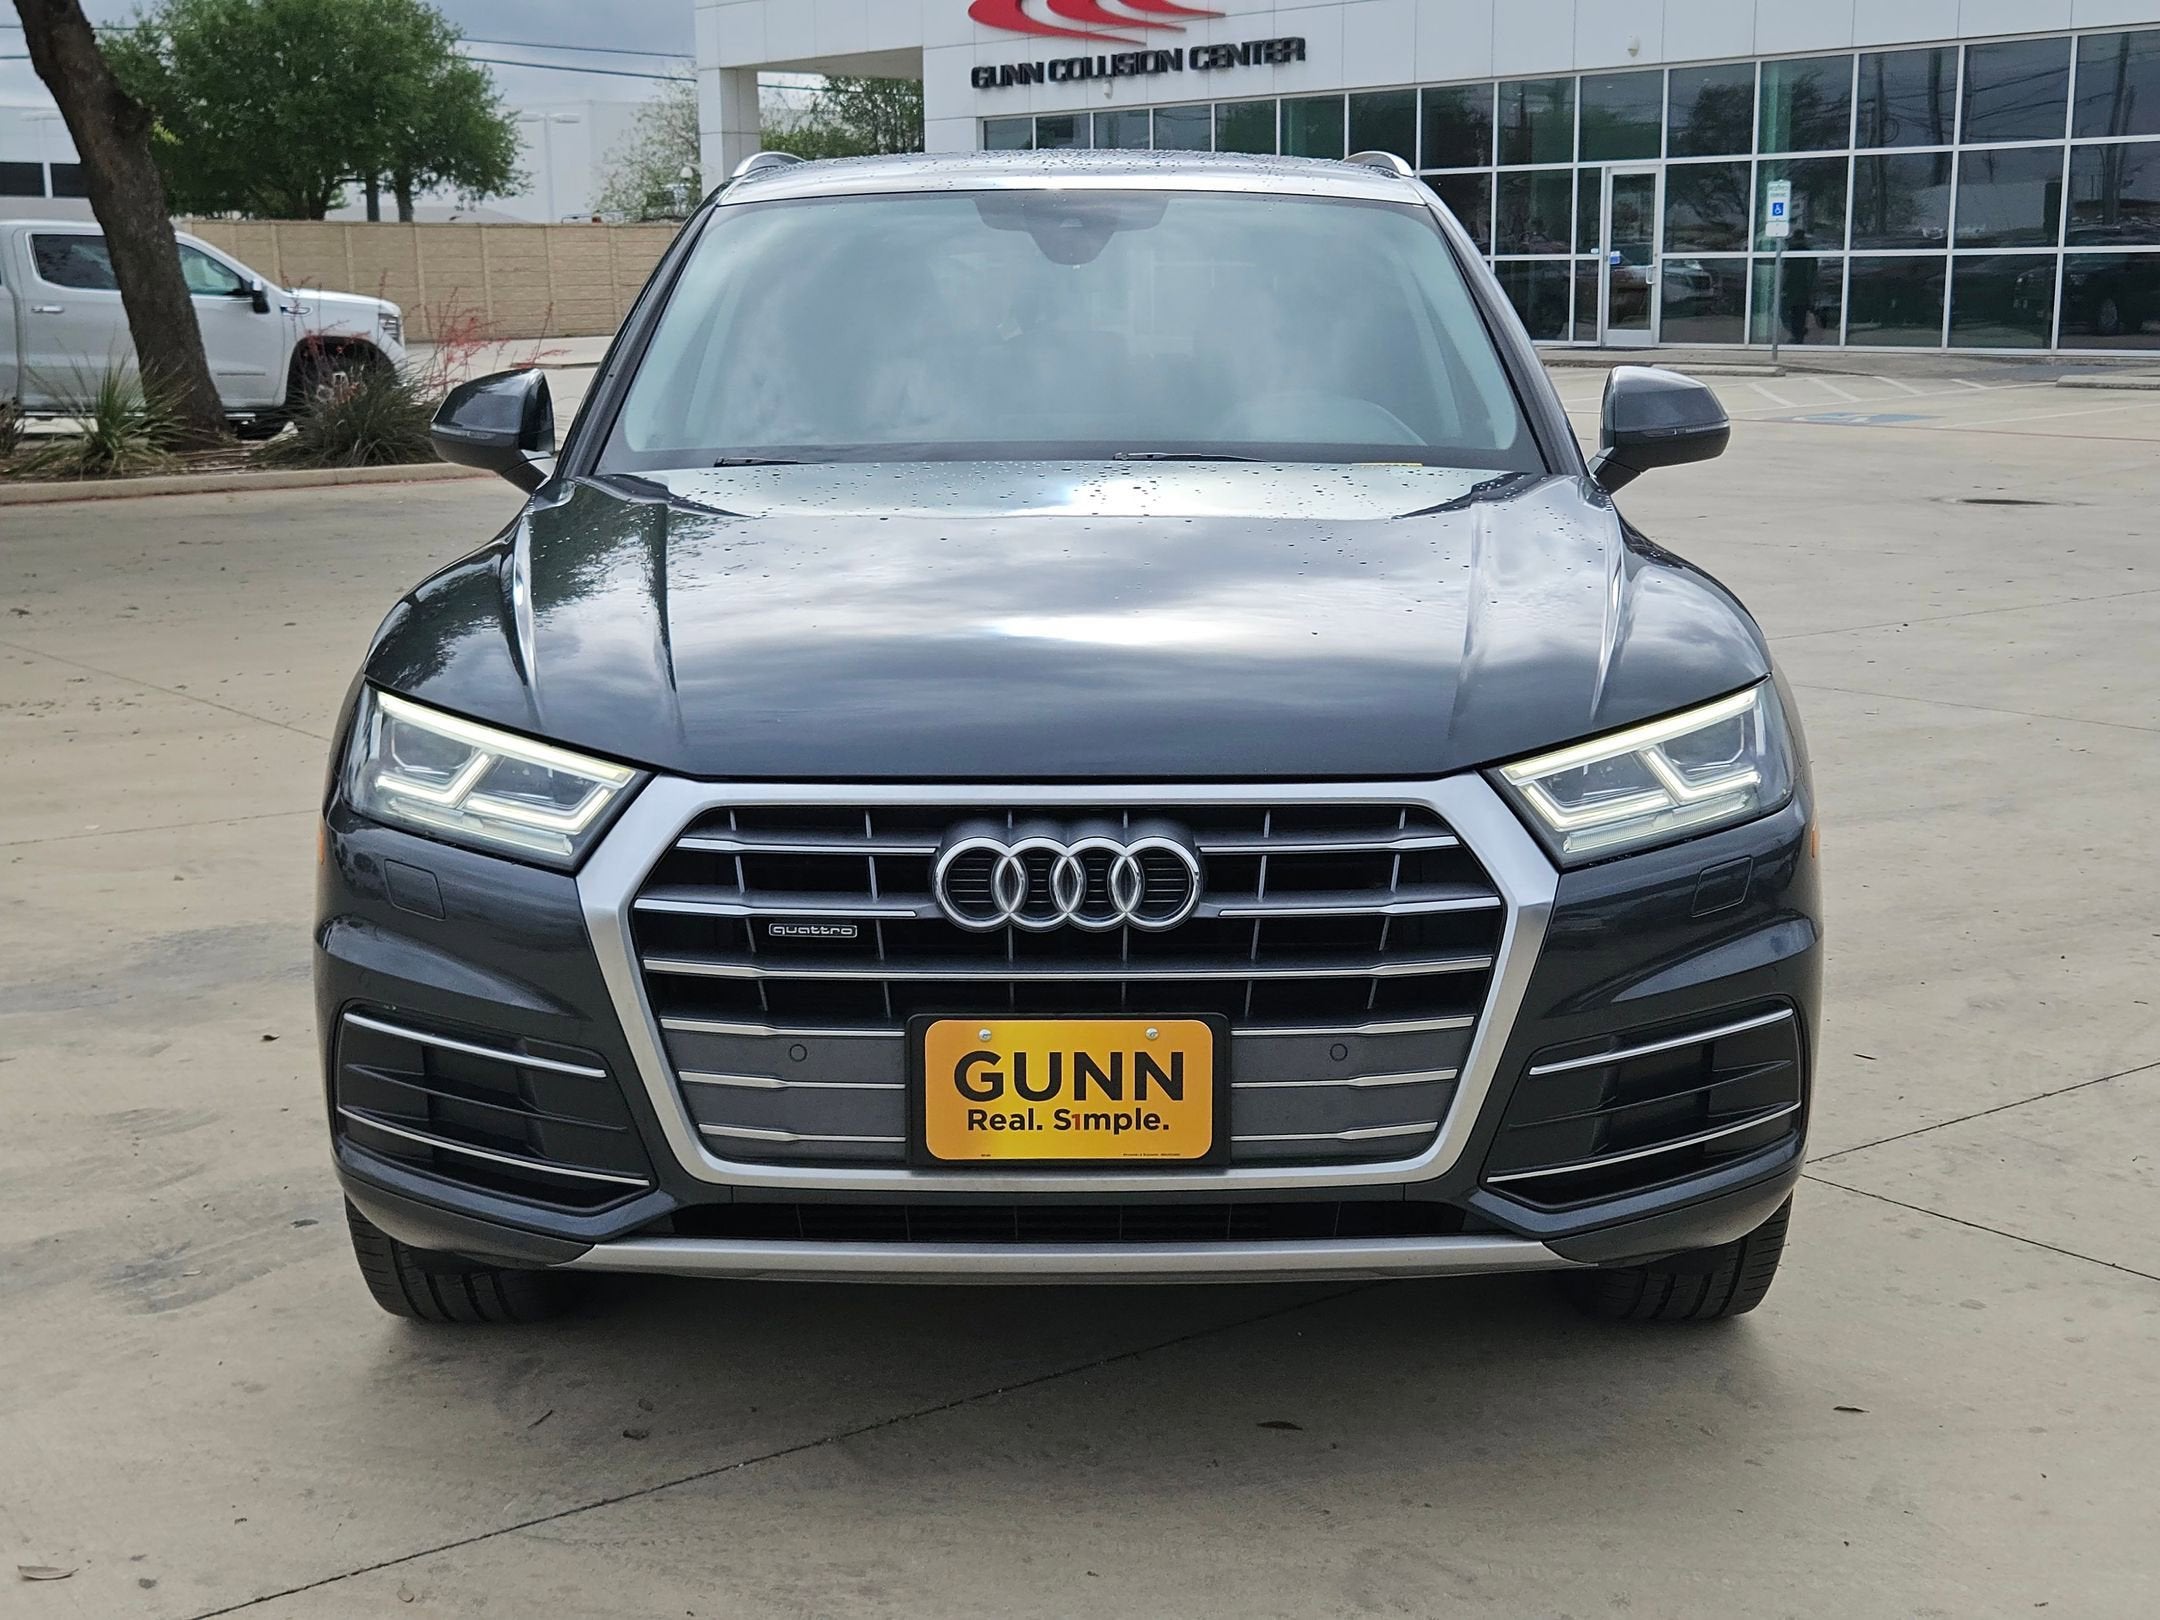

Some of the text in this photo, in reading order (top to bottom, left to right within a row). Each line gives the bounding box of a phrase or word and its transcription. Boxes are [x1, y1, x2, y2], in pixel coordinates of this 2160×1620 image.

[971, 37, 1306, 88] GUNN COLLISION CENTER
[773, 926, 852, 935] quattro
[953, 1050, 1184, 1102] GUNN
[967, 1108, 1043, 1131] Real.
